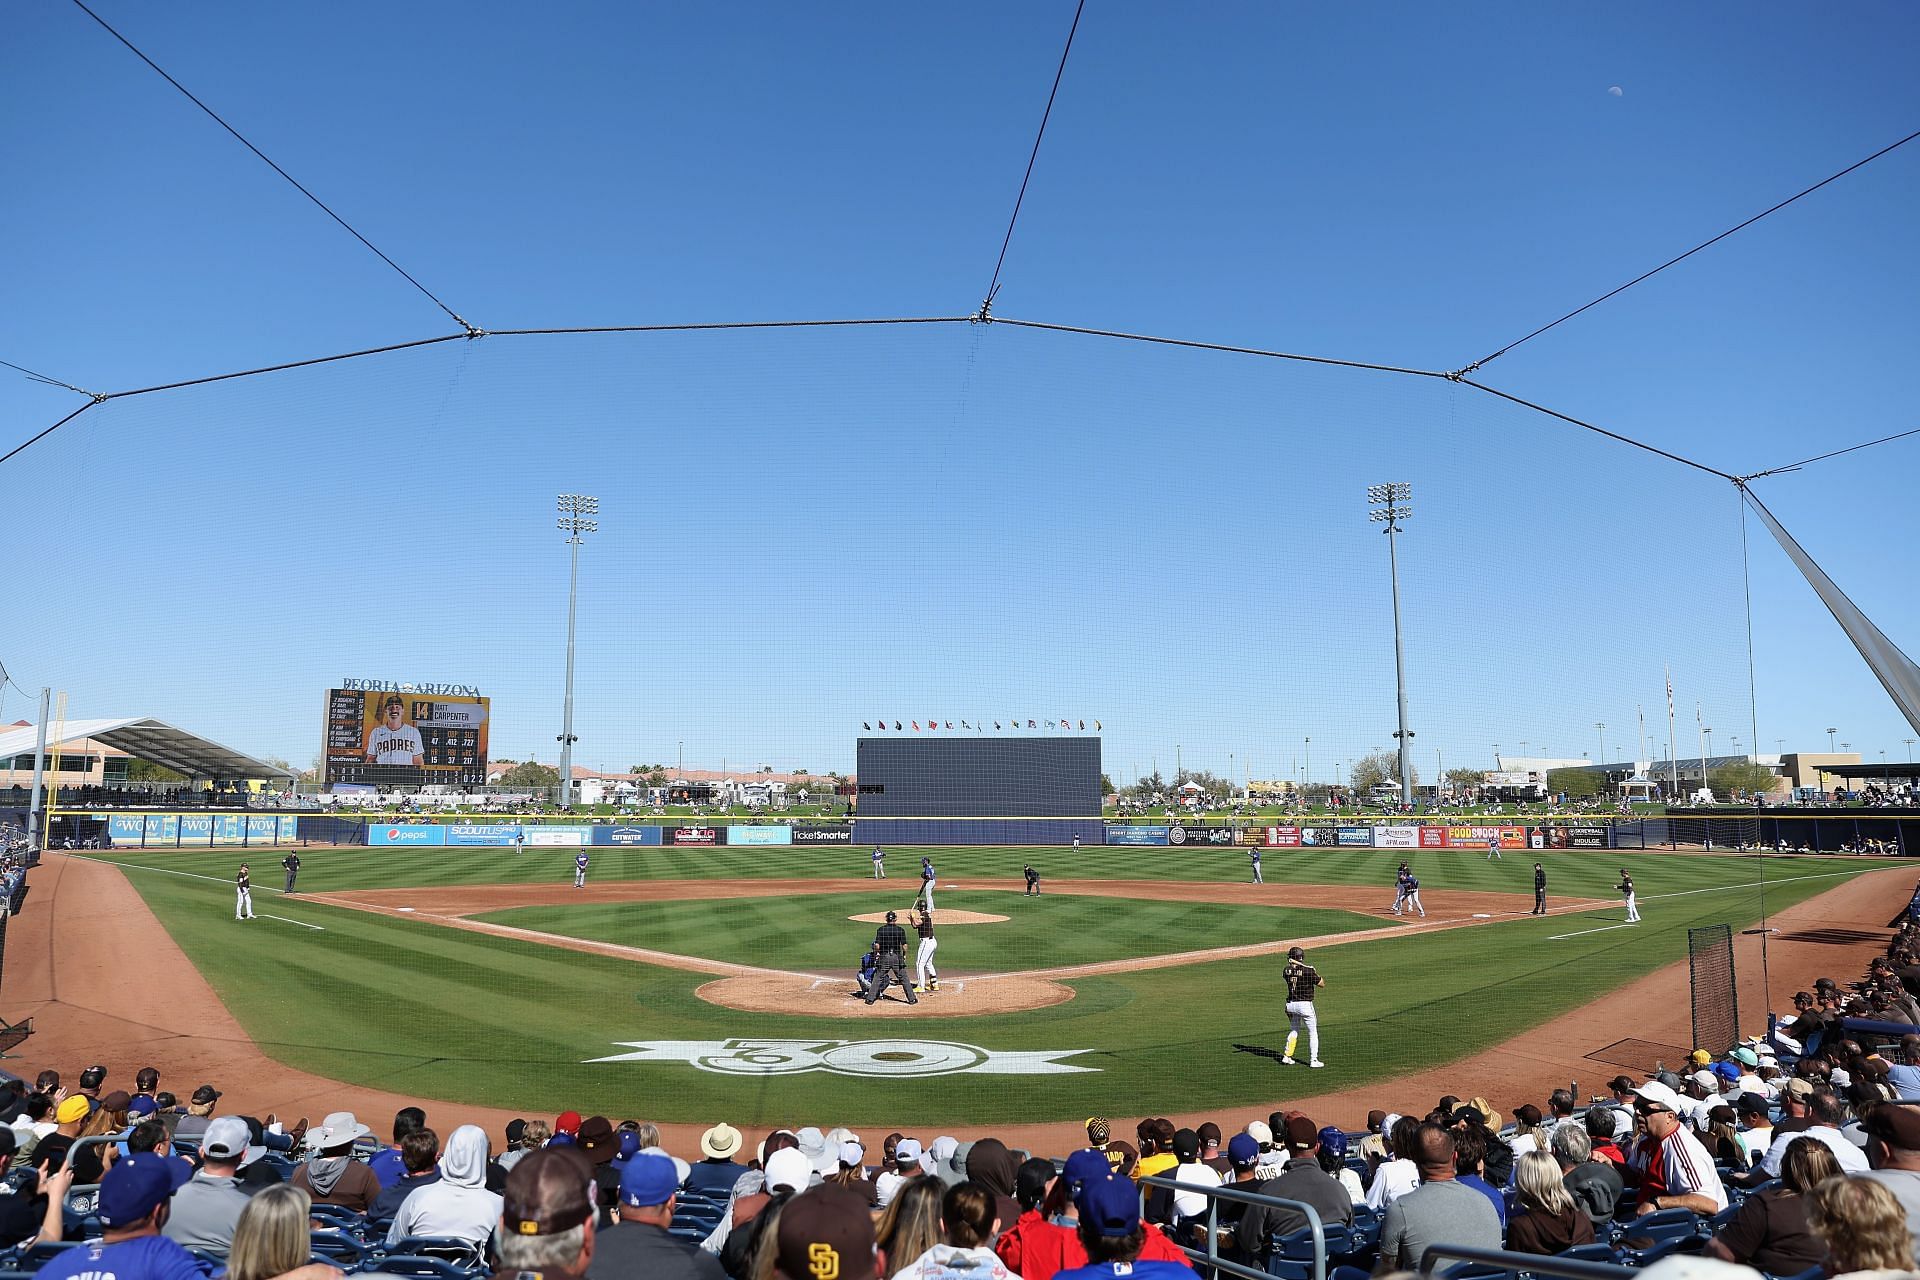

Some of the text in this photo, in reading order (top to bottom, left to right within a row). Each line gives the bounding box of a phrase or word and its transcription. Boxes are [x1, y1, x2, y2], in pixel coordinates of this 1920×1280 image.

[343, 678, 481, 697] PEORIA ARIZONA
[416, 703, 428, 719] 14
[434, 712, 469, 720] CARPENTER
[377, 739, 415, 755] PADRES
[463, 774, 483, 783] 0 2 2
[116, 820, 159, 831] WOW
[182, 820, 221, 831] WOW
[241, 820, 276, 831] WOW
[401, 831, 427, 840] pepsi
[793, 831, 850, 839] TicketSmarter
[631, 1193, 639, 1206] LA
[808, 1243, 839, 1280] SD
